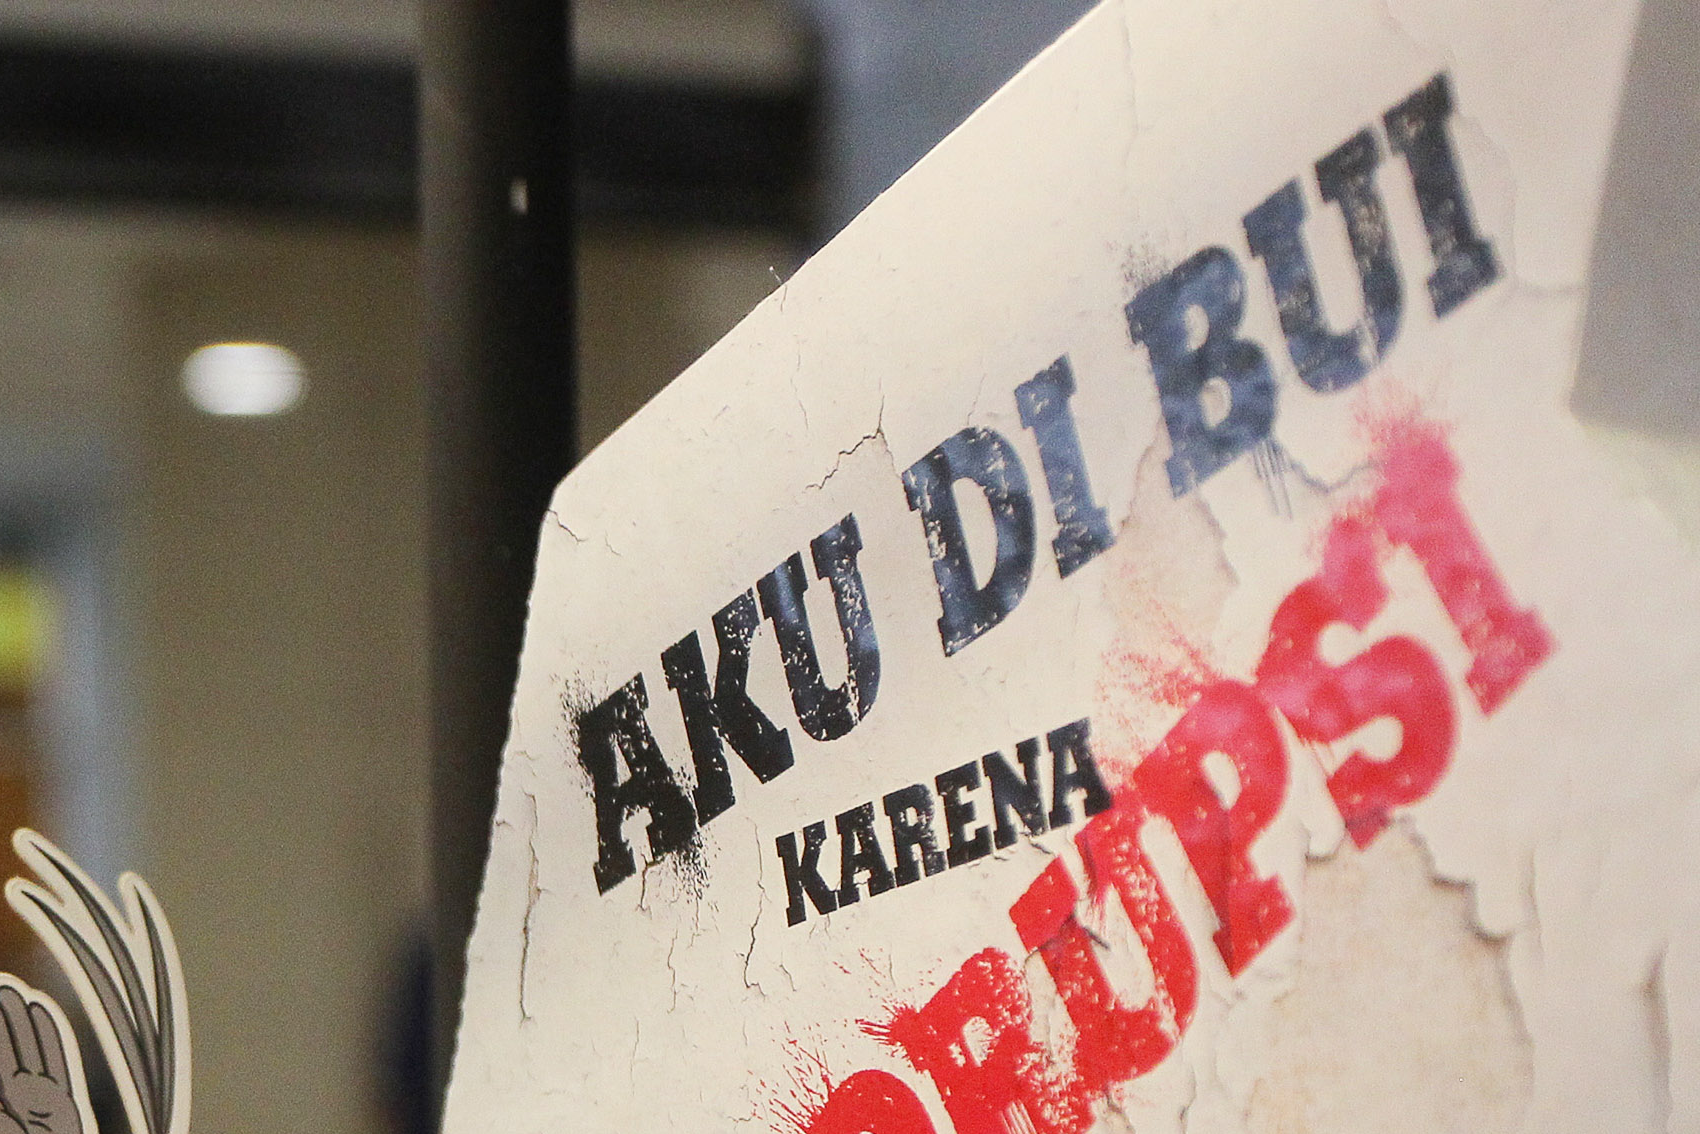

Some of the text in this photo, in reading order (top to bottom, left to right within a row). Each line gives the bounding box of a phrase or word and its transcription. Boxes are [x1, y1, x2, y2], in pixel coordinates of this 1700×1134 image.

[572, 70, 1501, 896] AKU DI BUI
[775, 717, 1114, 927] KARENA
